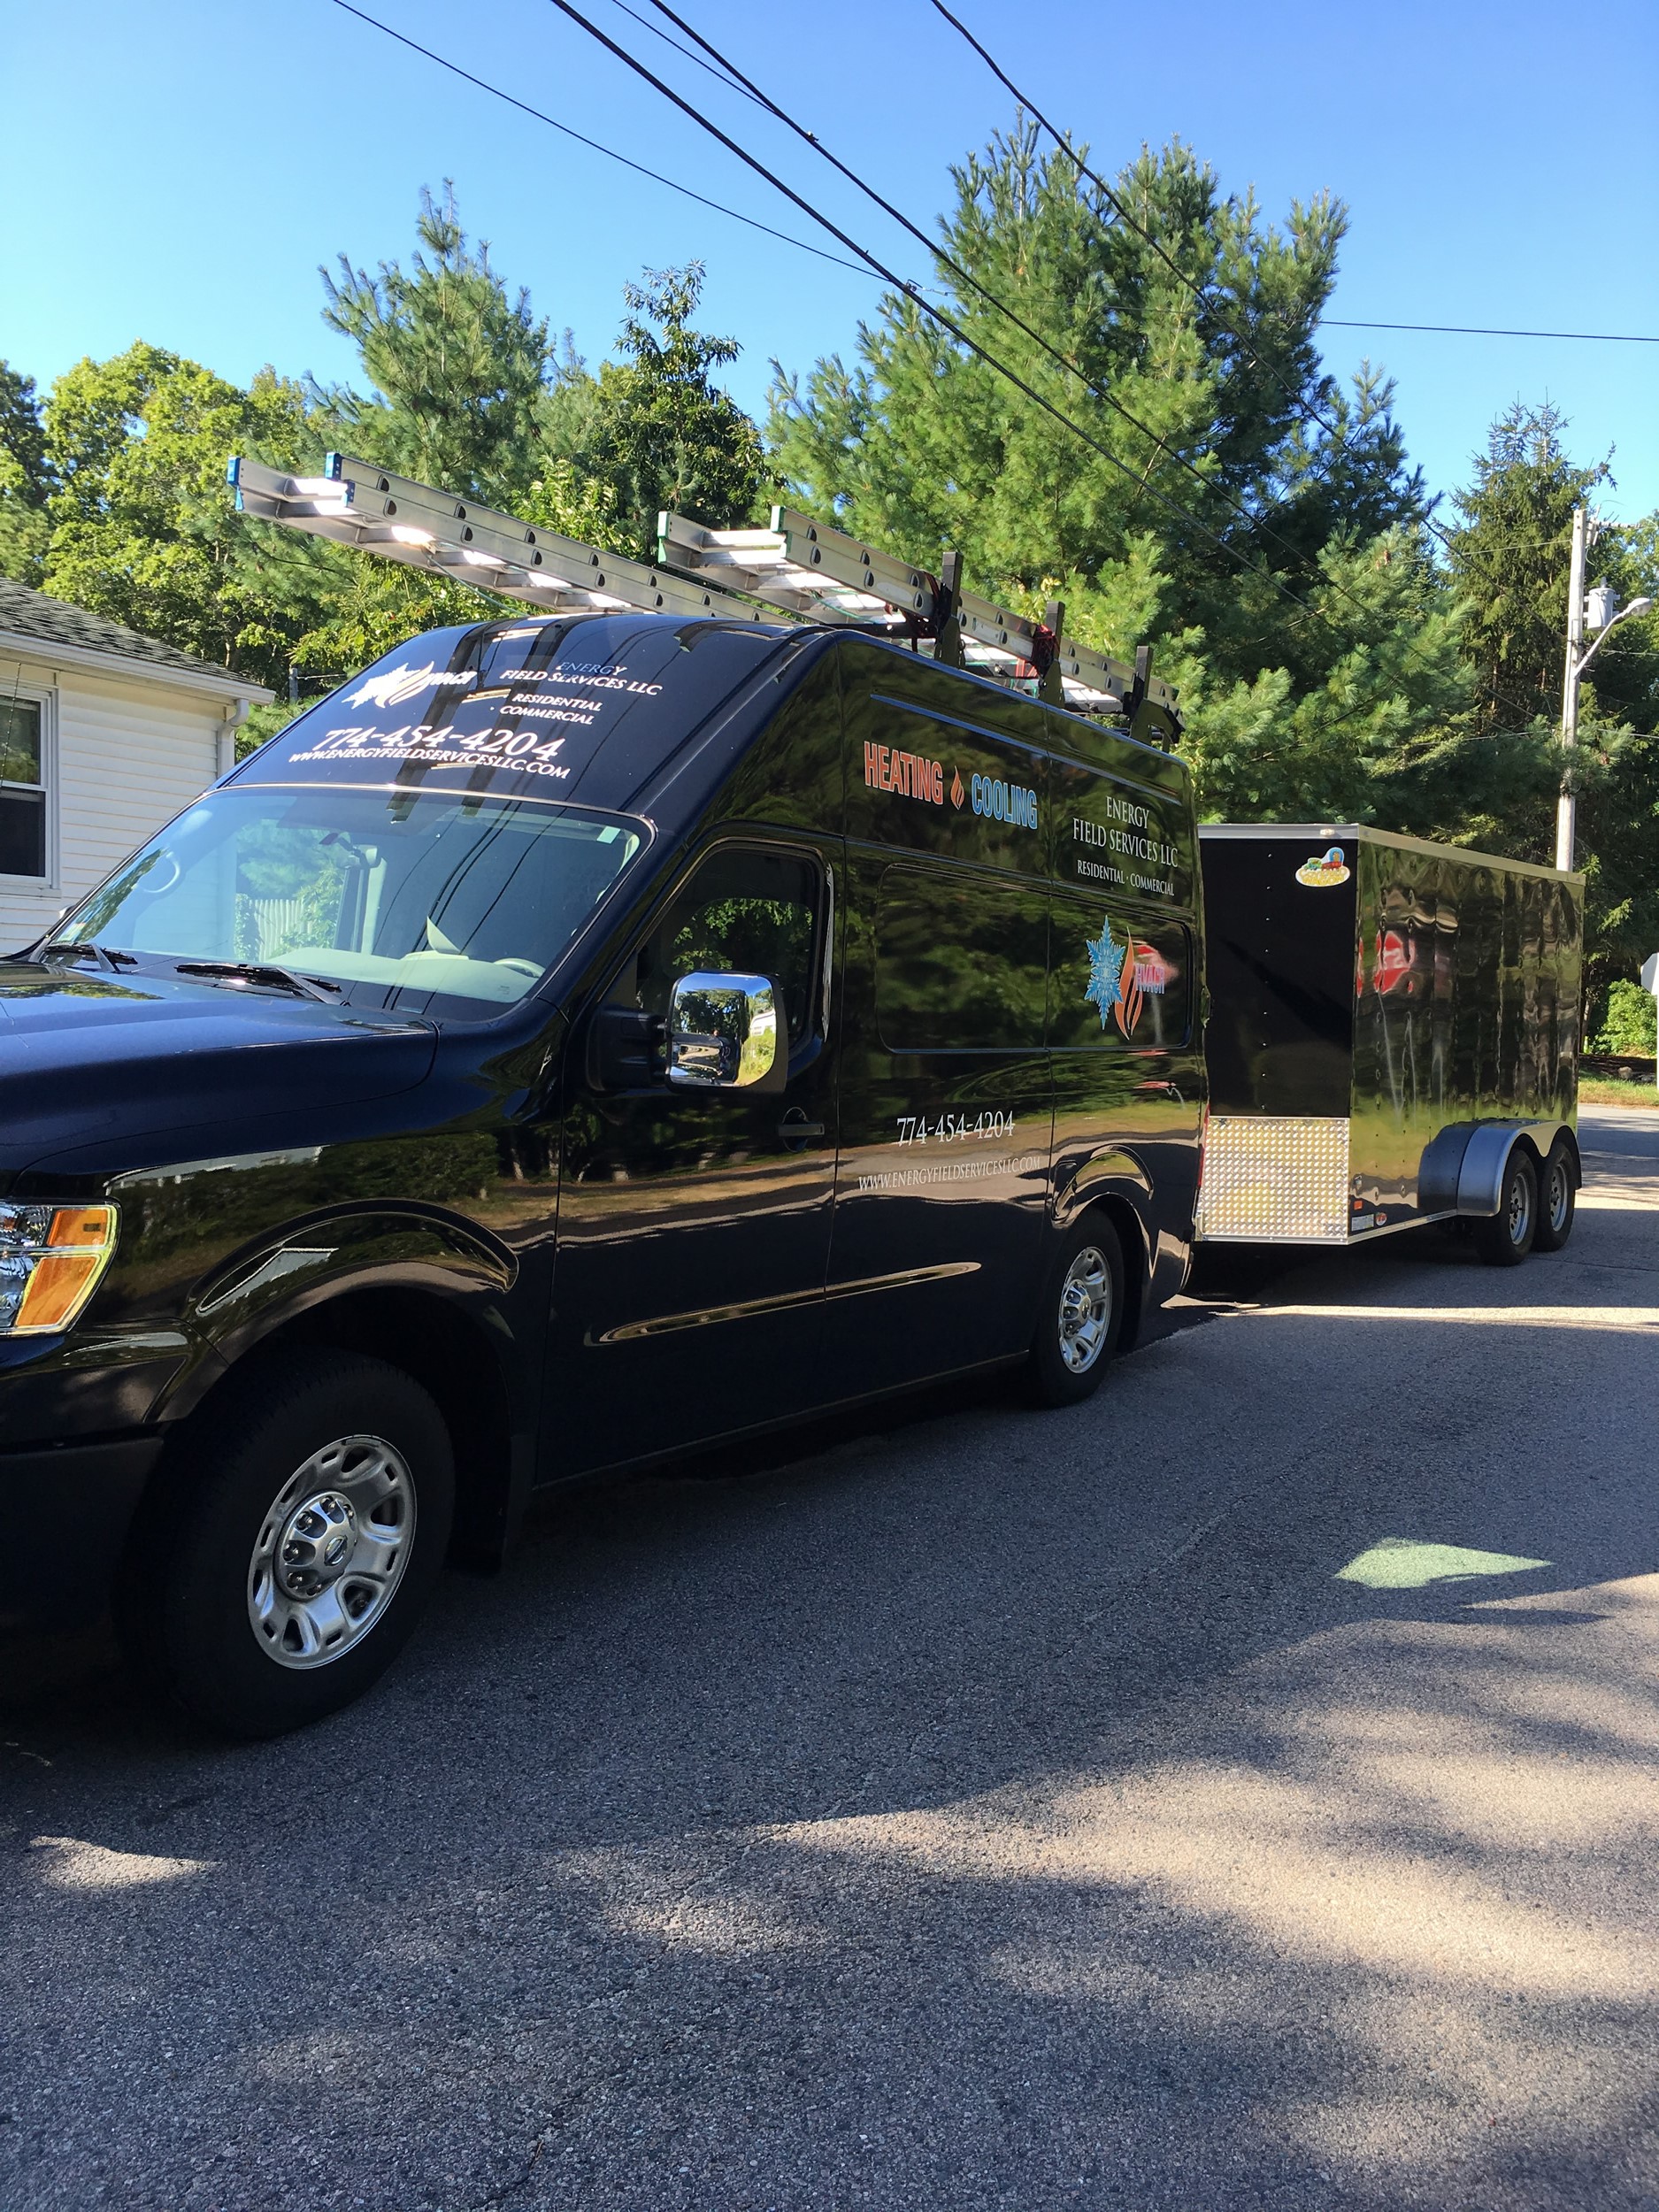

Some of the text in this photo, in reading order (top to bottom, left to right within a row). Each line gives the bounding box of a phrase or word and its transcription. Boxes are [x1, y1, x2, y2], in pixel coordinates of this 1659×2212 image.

[500, 670, 663, 696] FIELD SERVICES LLC
[556, 662, 628, 676] ENERGY
[500, 705, 595, 726] COMMERCIAL
[512, 694, 603, 711] RESIDENTIAL
[312, 726, 566, 762] 774-454-4204
[288, 748, 572, 780] WWW.ENERGYFIELDSERVICESLLC.COM
[864, 741, 1038, 830] HEATING COOLING
[1106, 795, 1149, 829] ENERGY
[1072, 817, 1179, 868] FIELD SERVICES LLC
[1077, 859, 1175, 896] RESIDENTIAL COMMERCIAL
[896, 1110, 1016, 1147] 774-454-4204
[858, 1156, 1041, 1192] WWW.ENERGYFIELDSERVICESLLC.COM
